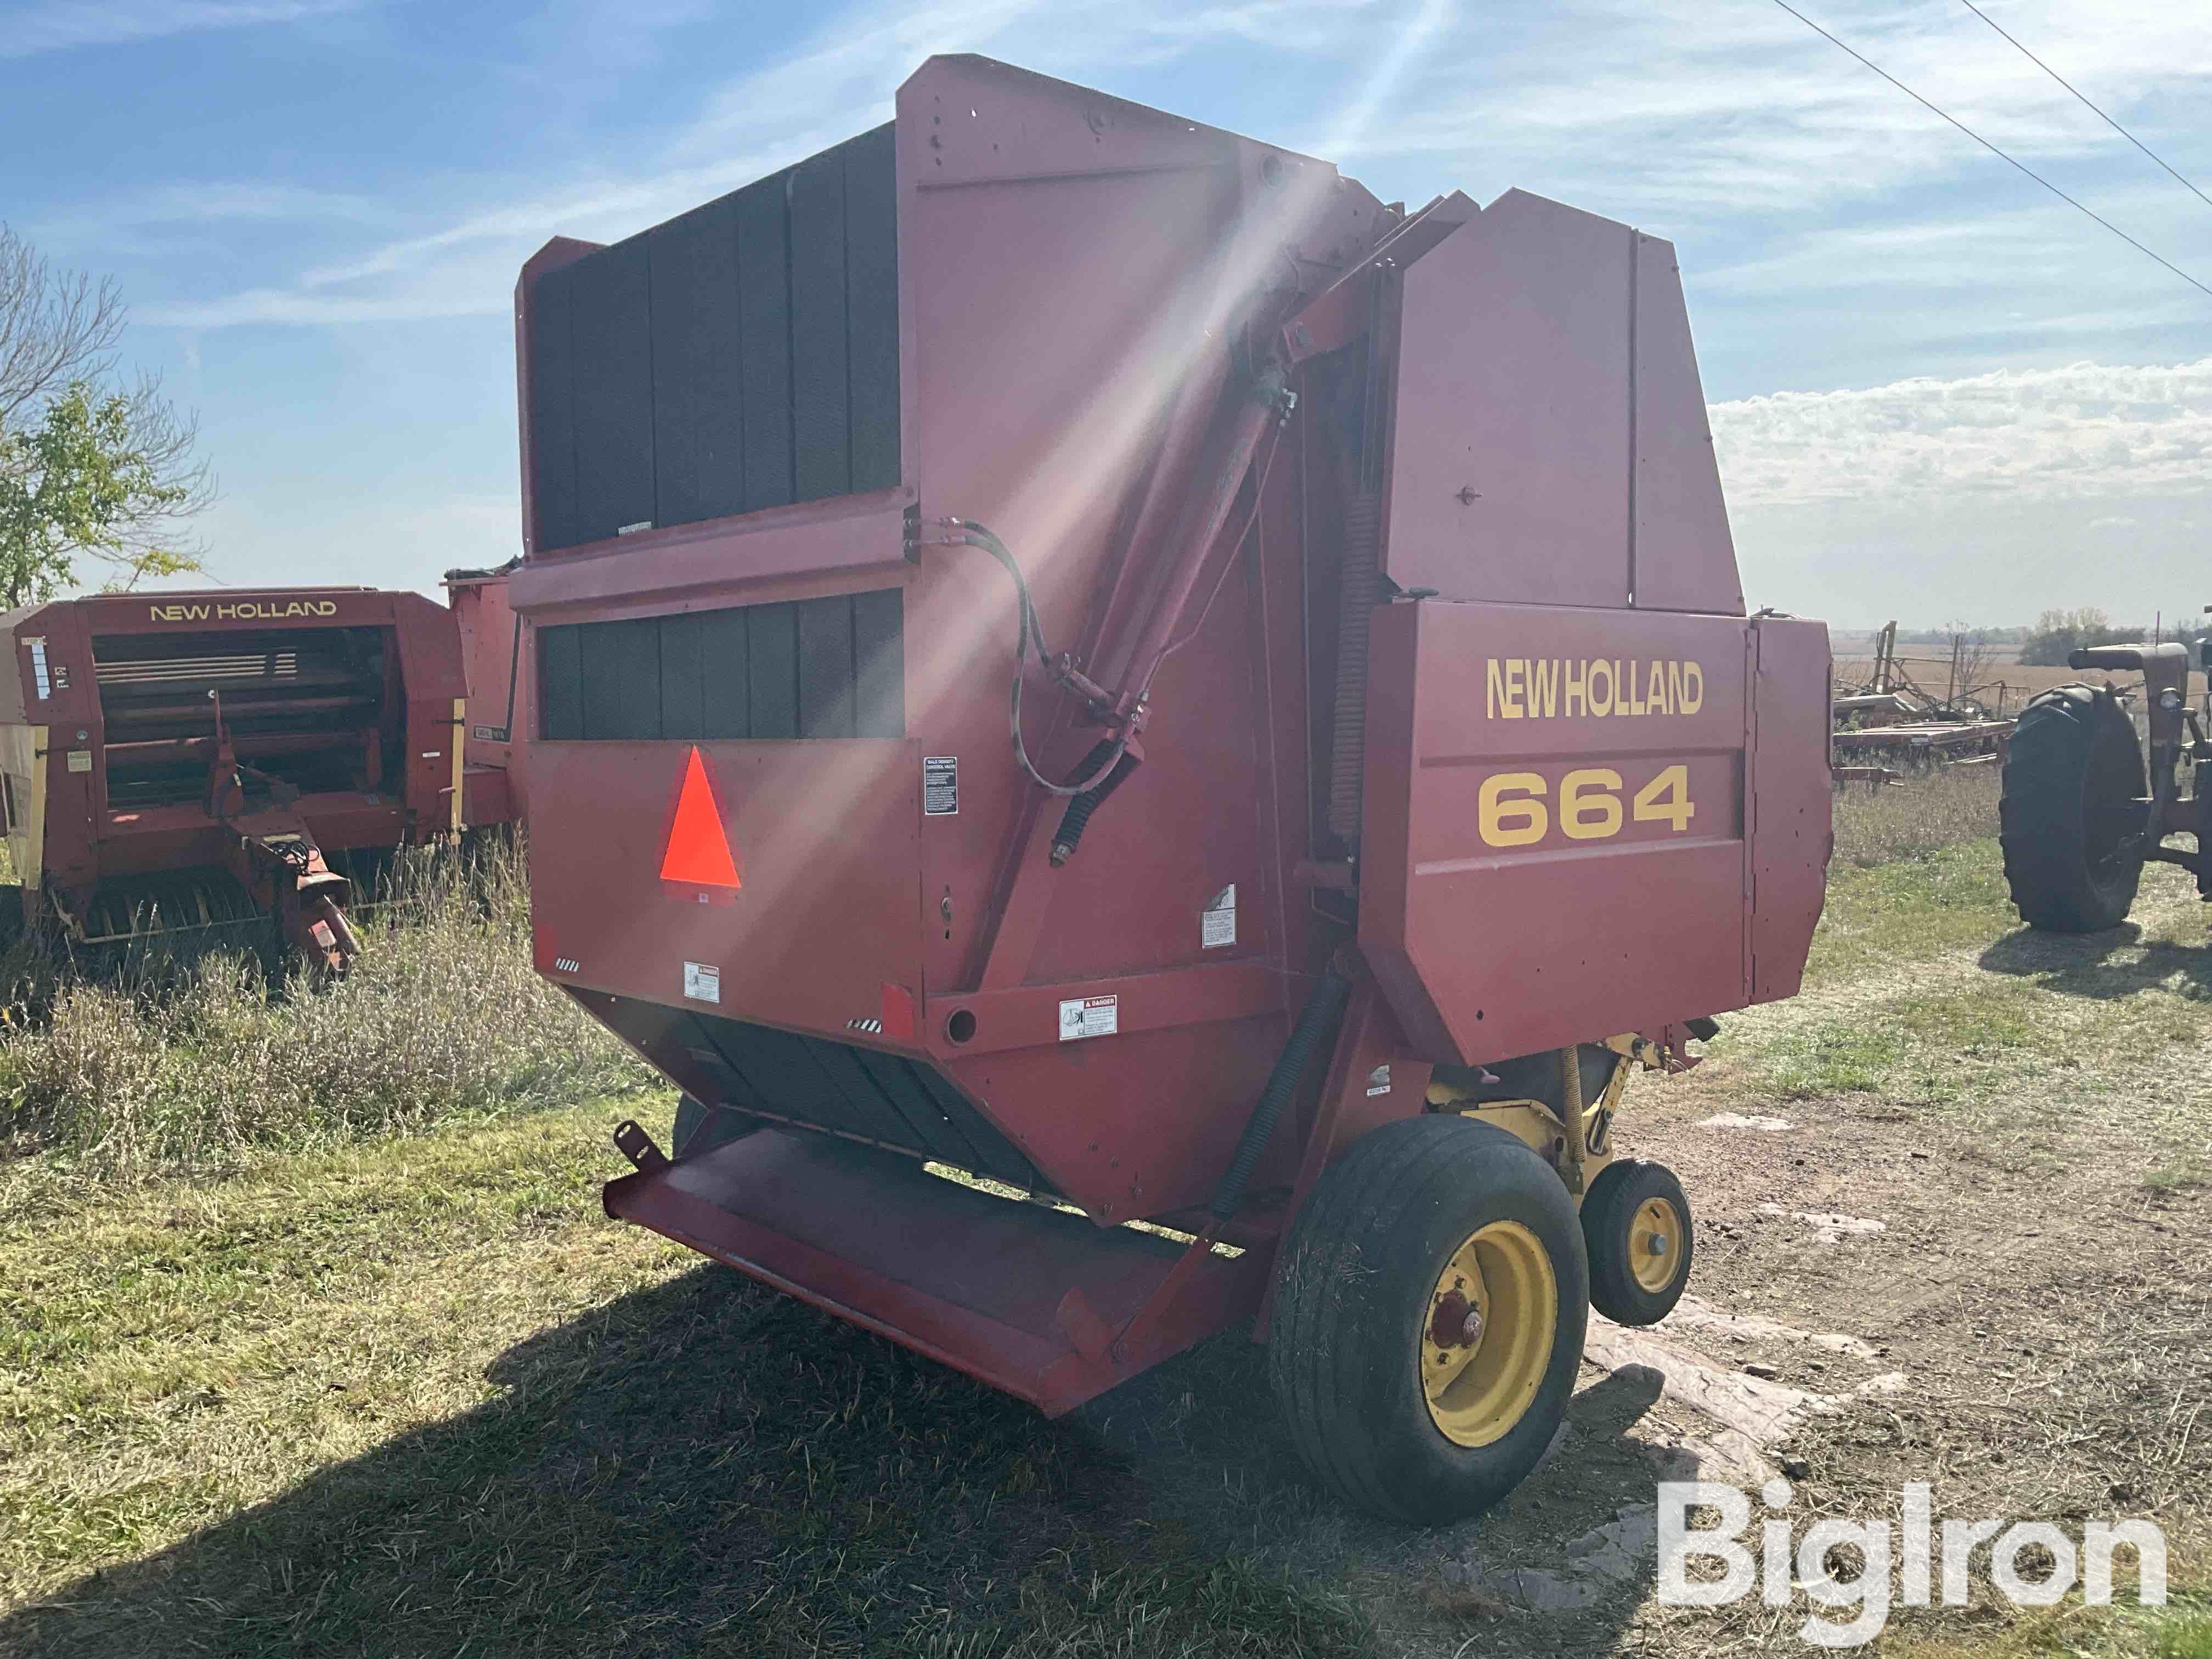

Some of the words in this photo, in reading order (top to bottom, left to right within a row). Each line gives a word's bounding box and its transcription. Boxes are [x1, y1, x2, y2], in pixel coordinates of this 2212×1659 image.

[150, 605, 210, 621] NEW
[217, 601, 337, 619] HOLLAND
[1487, 658, 1559, 719] NEW
[1565, 658, 1703, 716] HOLLAND
[1479, 765, 1695, 847] 664
[1092, 998, 1115, 1006] DANGER
